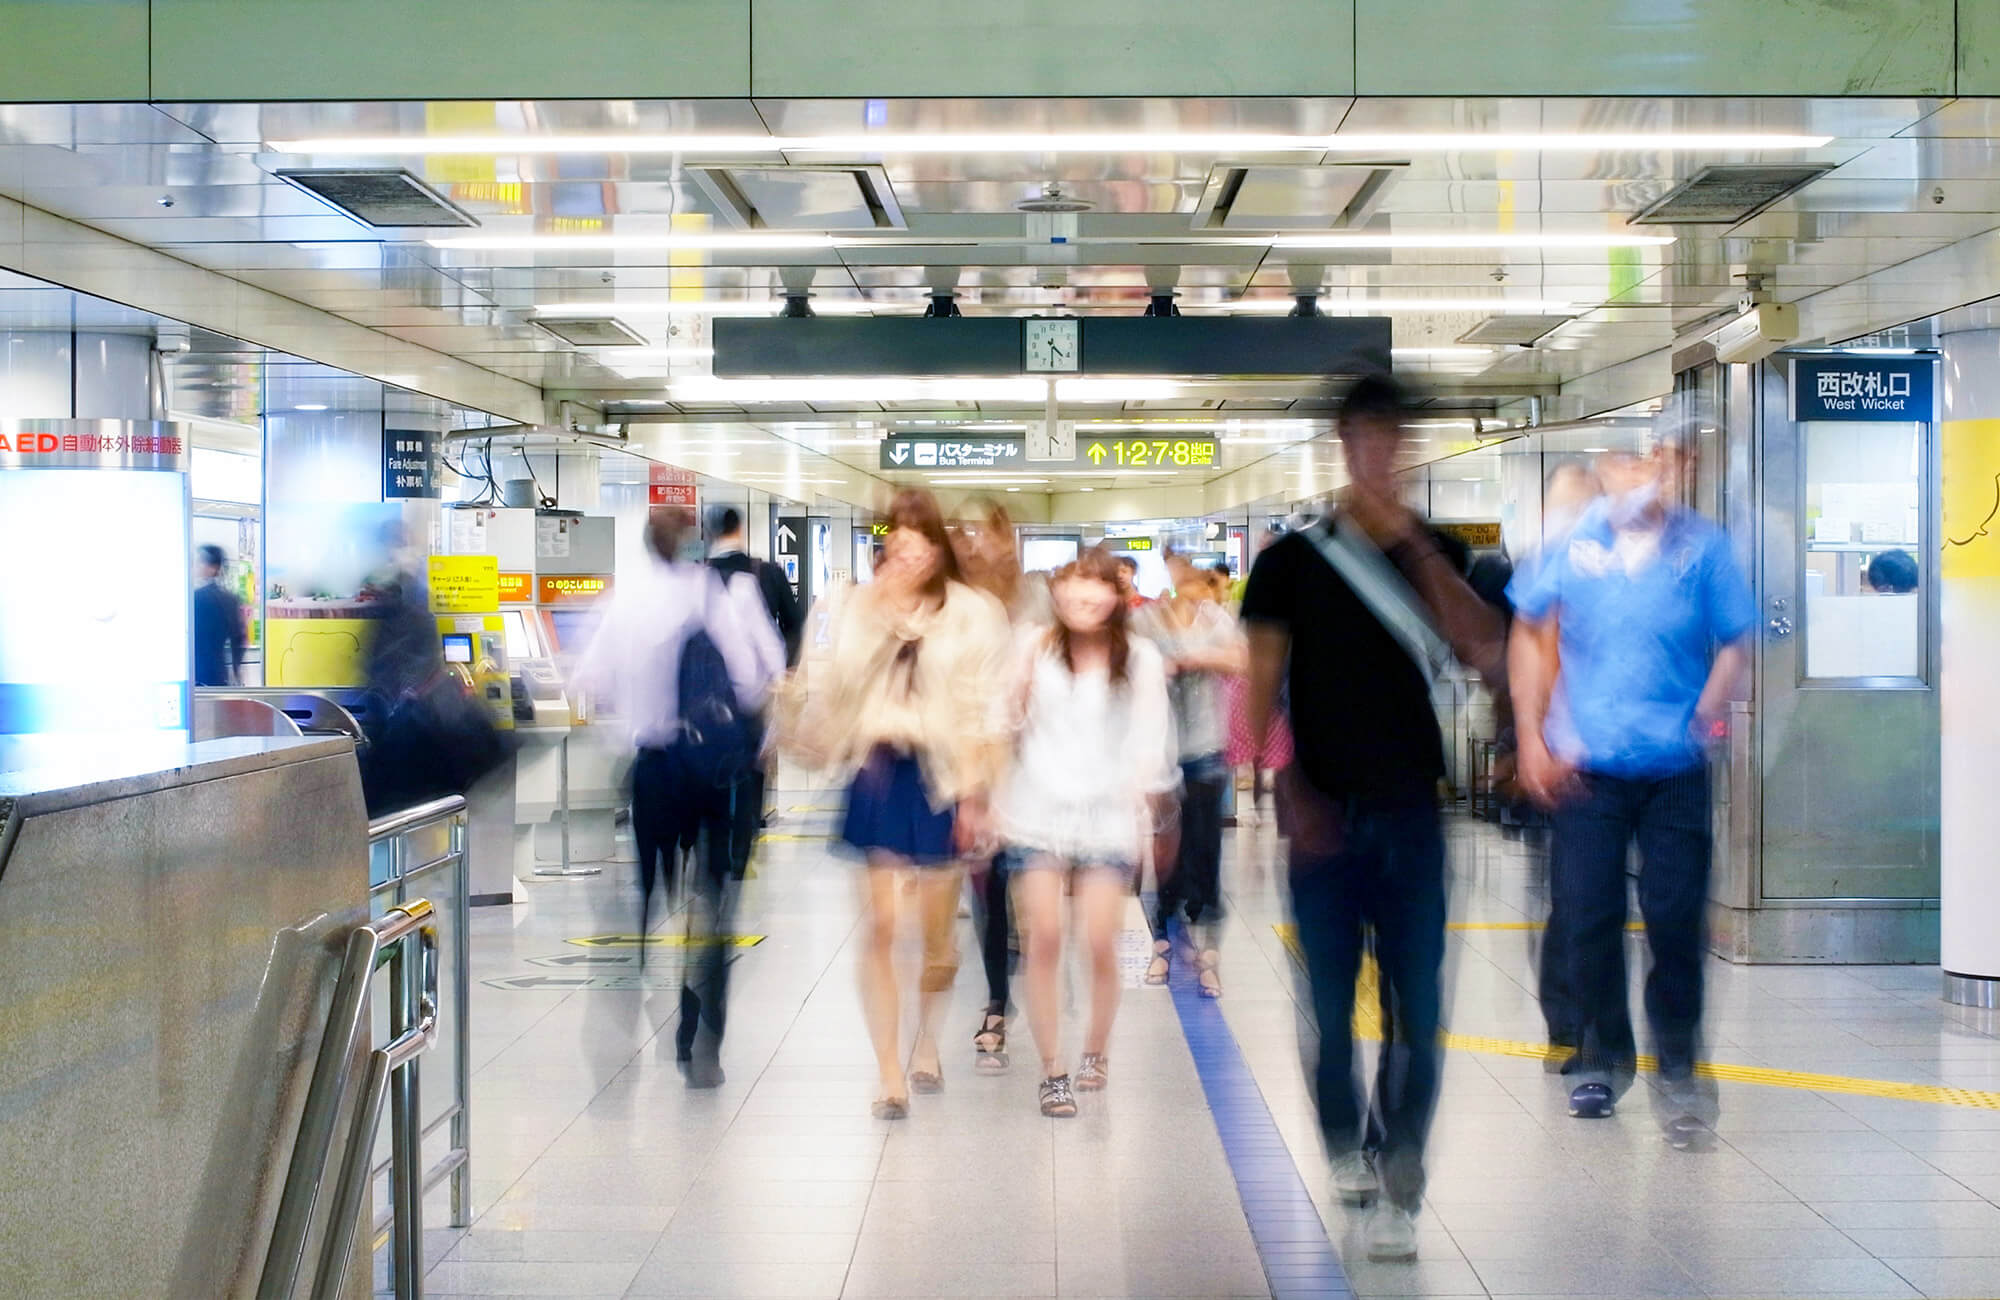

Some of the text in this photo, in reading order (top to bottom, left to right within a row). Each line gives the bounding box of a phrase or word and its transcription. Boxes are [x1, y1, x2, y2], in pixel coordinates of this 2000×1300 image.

[1816, 371, 1911, 398] 西改札口
[1823, 398, 1905, 410] West Wicket
[0, 433, 182, 455] AED 自動体外除細動器
[938, 442, 1018, 457] バスターミナル
[1190, 441, 1215, 456] 出口
[939, 456, 994, 466] Bus Terminal
[1191, 456, 1212, 465] Exits
